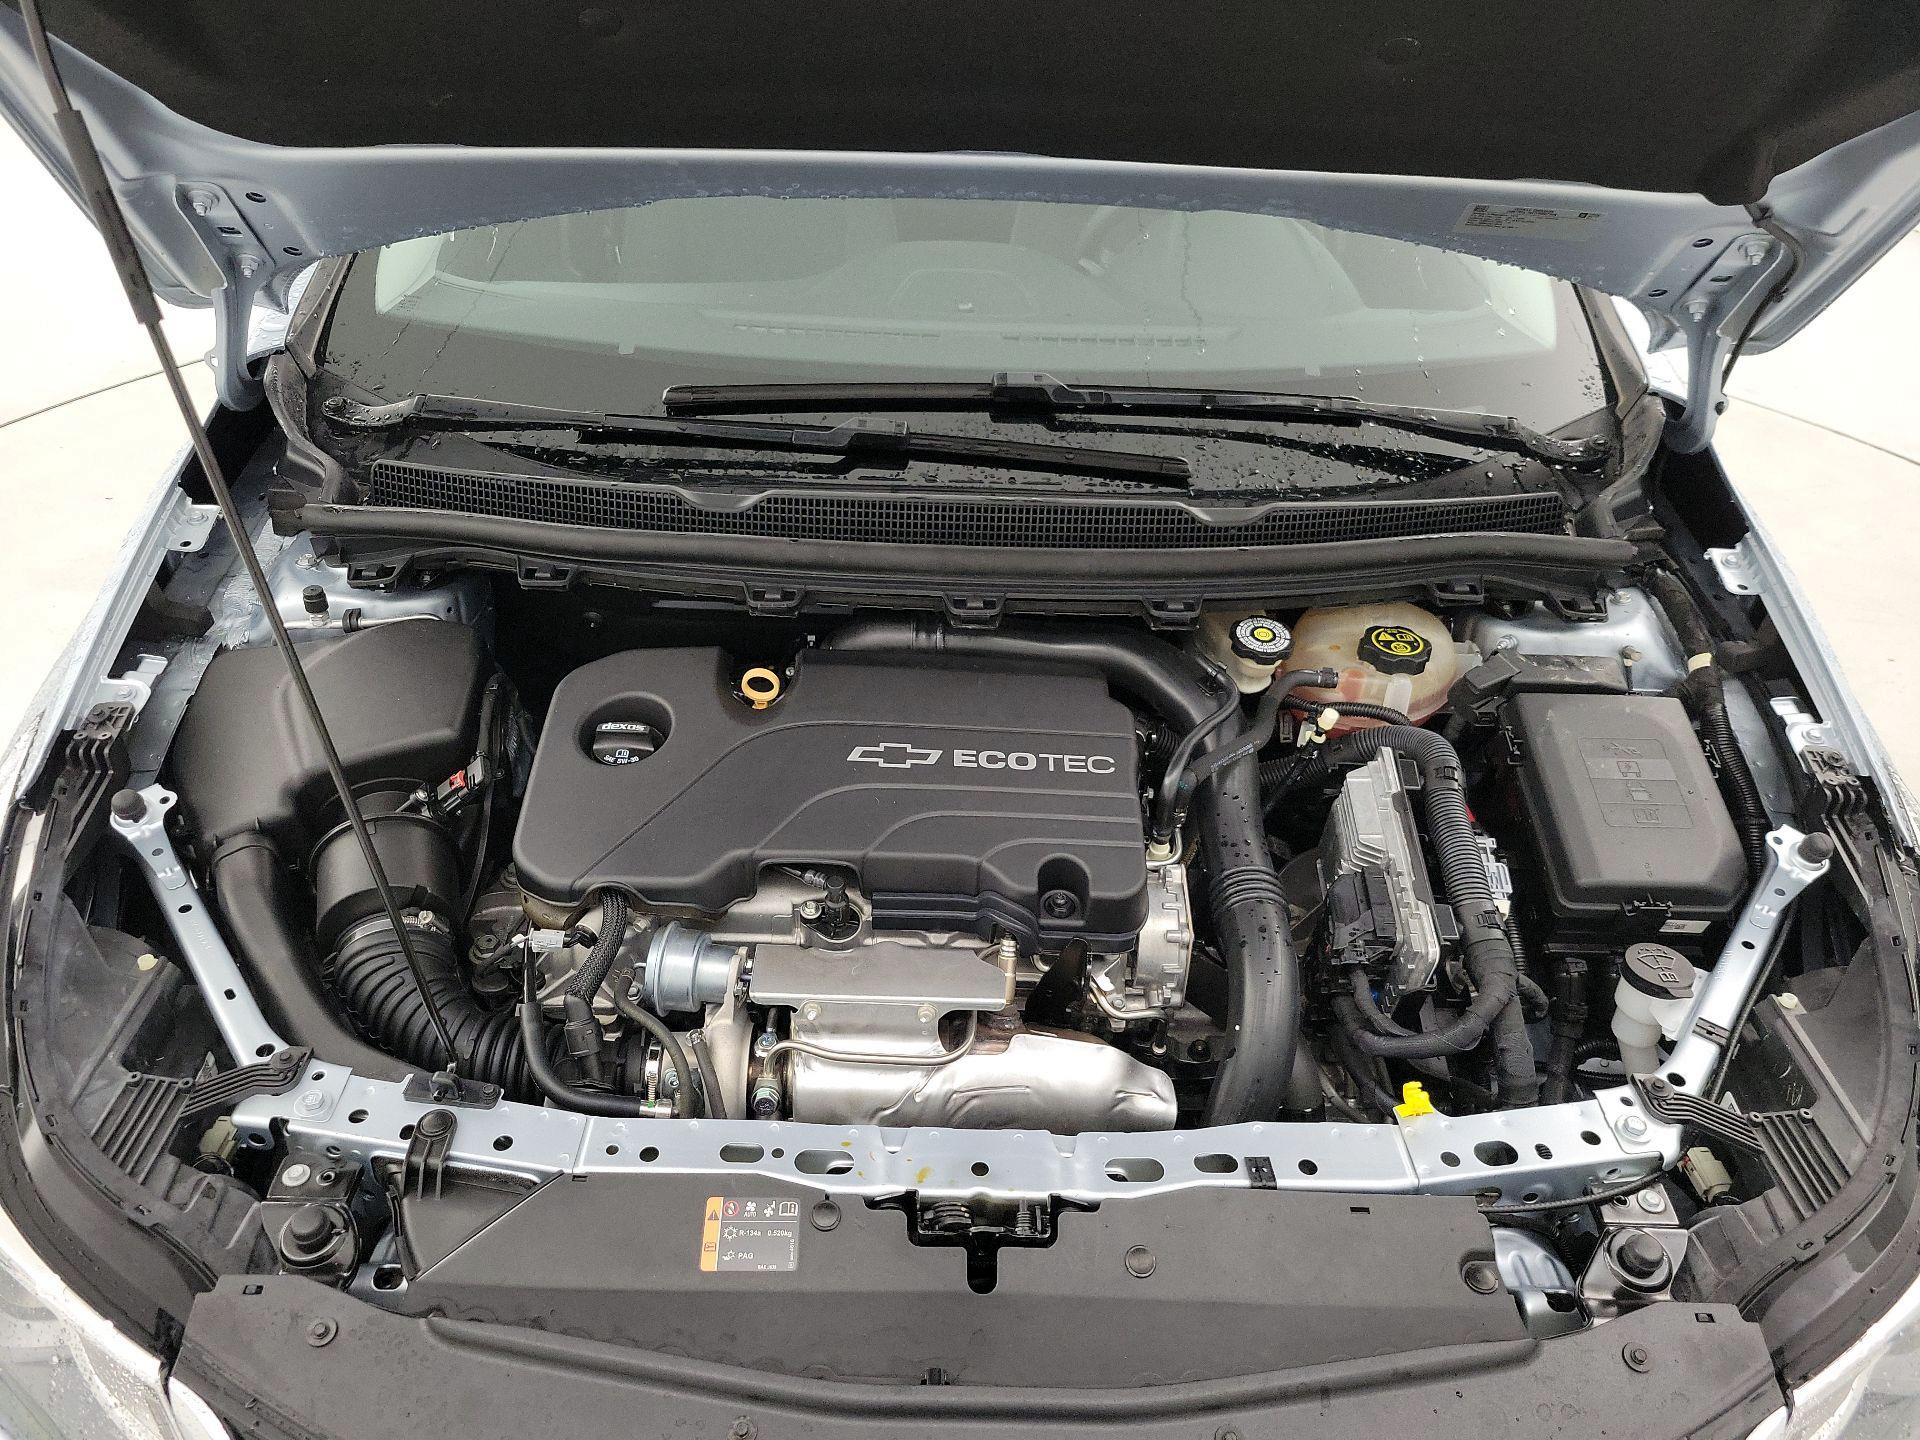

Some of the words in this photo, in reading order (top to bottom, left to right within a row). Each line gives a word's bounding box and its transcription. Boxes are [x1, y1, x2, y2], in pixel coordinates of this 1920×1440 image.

[601, 722, 647, 731] dexos
[603, 755, 616, 763] SAE
[616, 756, 640, 764] 5W-30
[953, 750, 1116, 775] ECOTEC
[737, 1252, 754, 1260] PAG
